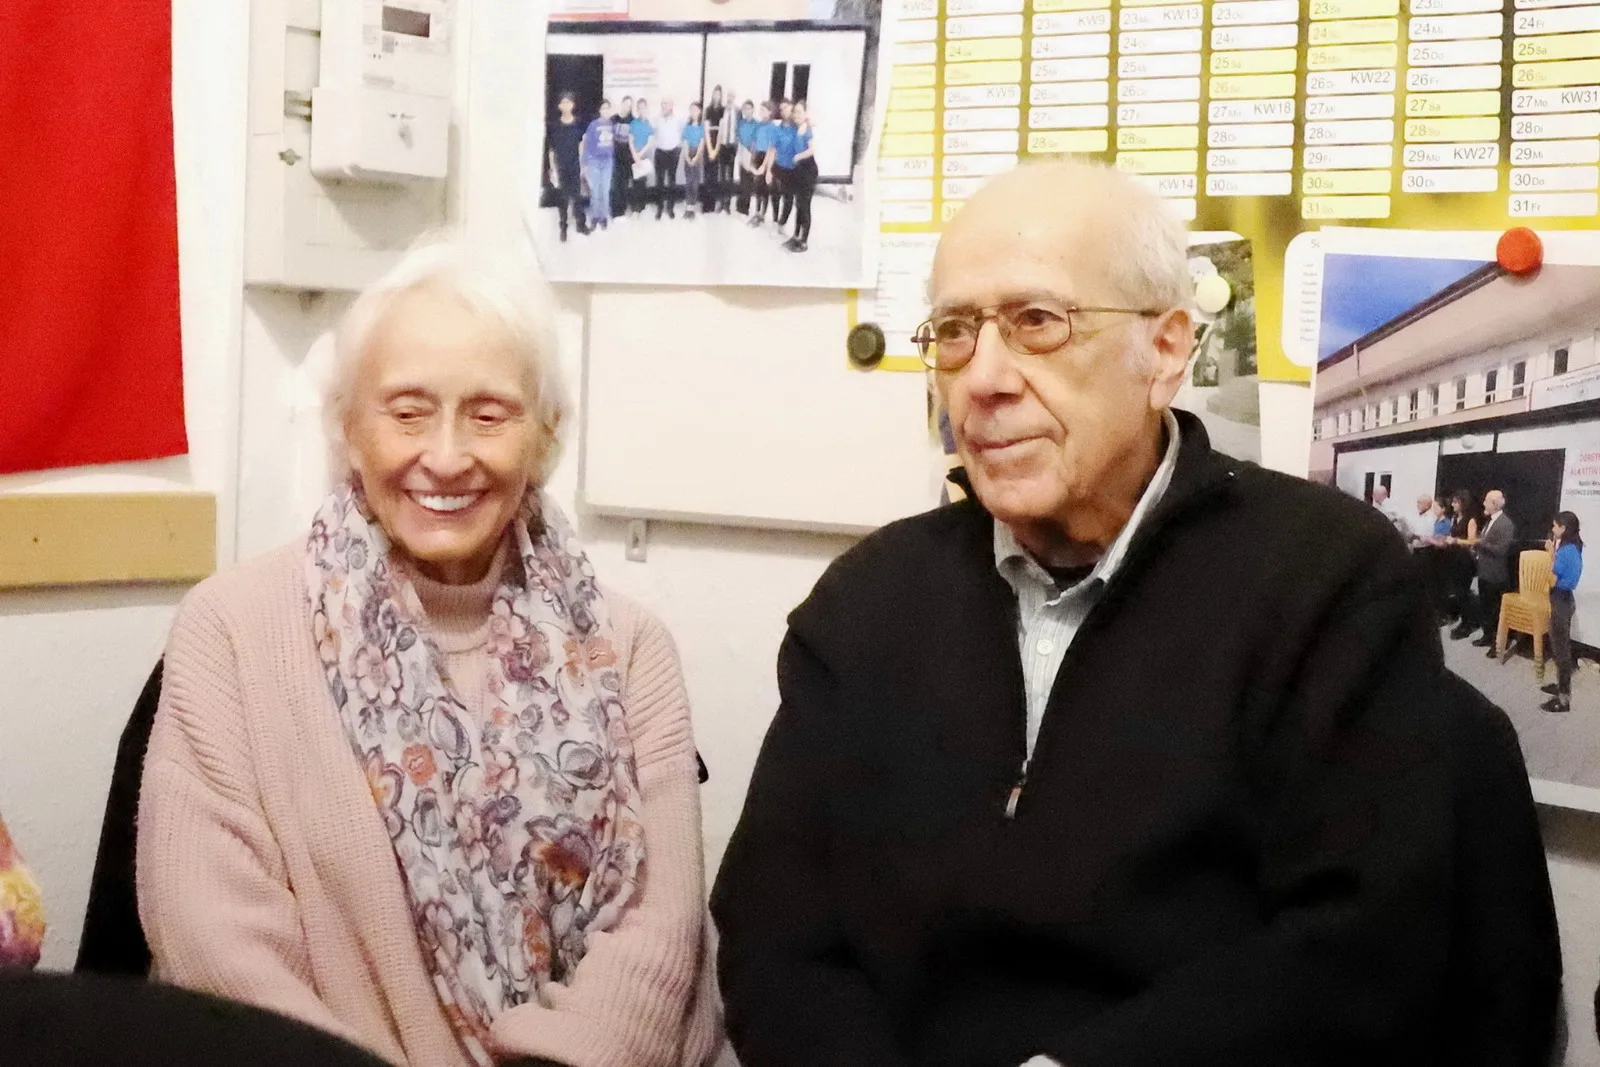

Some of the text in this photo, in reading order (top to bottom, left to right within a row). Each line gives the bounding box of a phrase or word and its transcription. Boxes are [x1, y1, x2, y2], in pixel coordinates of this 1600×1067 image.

[1519, 17, 1534, 29] 24
[1519, 44, 1533, 56] 25
[1350, 72, 1390, 84] KW22
[1411, 100, 1427, 111] 27
[1517, 96, 1533, 108] 27
[1561, 91, 1598, 105] KW31
[1516, 121, 1533, 134] 28
[1408, 150, 1425, 162] 29
[1453, 147, 1494, 160] KW27
[1515, 148, 1532, 160] 29
[1408, 176, 1424, 188] 30
[1514, 174, 1530, 186] 30
[1514, 200, 1528, 212] 31
